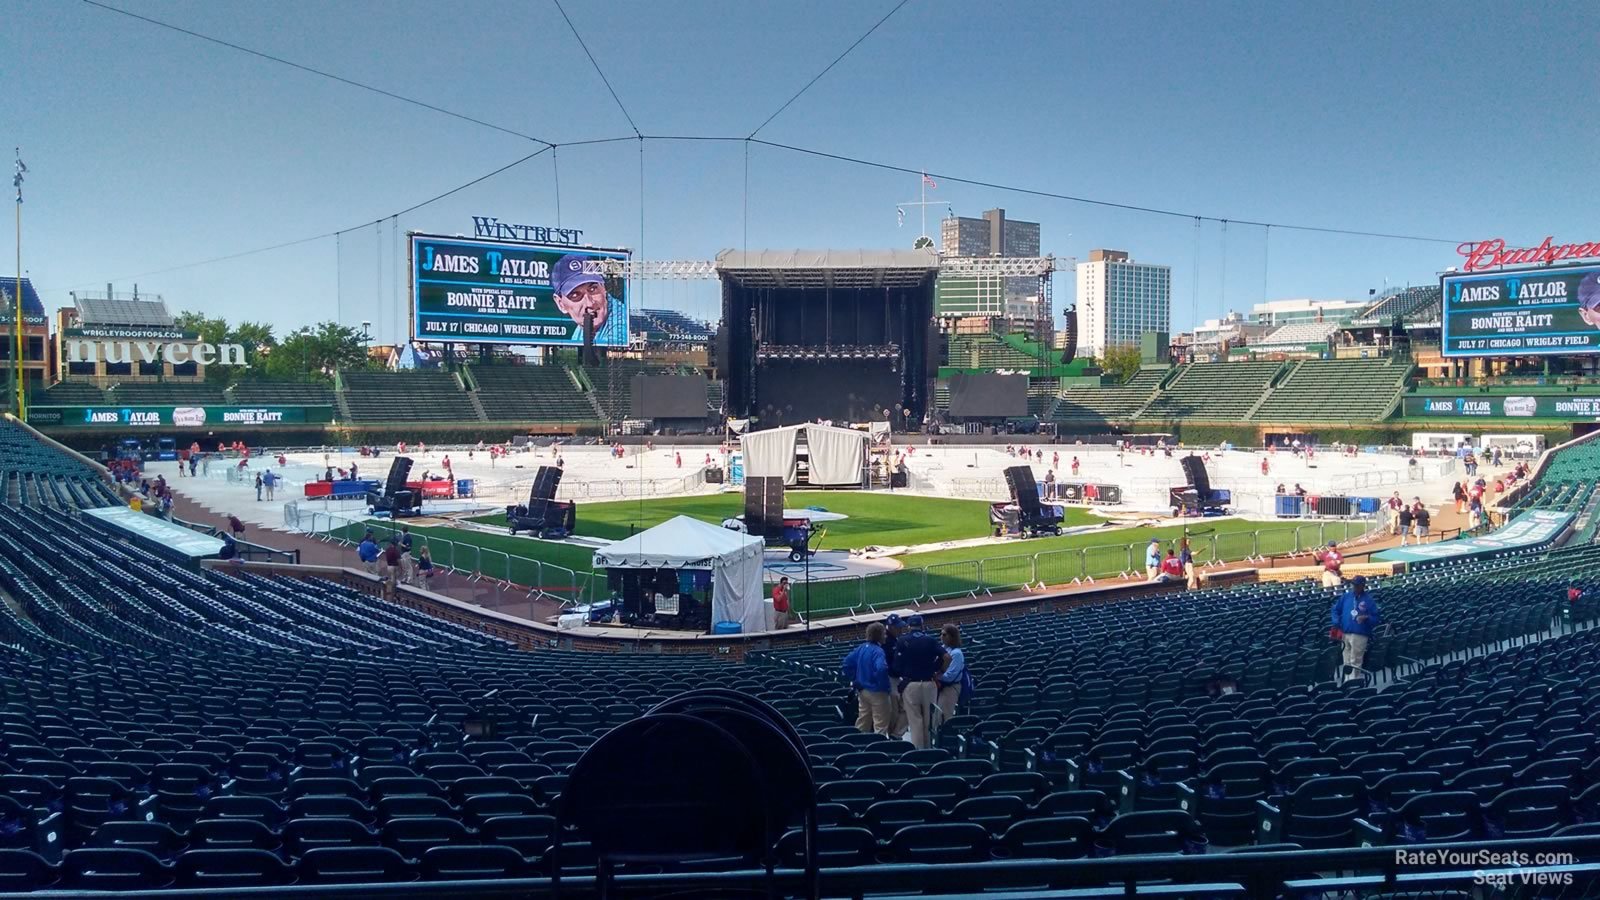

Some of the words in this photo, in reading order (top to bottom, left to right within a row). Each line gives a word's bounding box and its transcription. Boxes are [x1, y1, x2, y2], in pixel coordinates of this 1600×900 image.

[472, 216, 583, 245] WINTRUST
[447, 292, 494, 308] BONNIE
[498, 295, 537, 310] RAITT
[426, 321, 447, 332] JULY
[450, 322, 458, 332] 17
[464, 322, 498, 333] CHICAGO
[503, 324, 541, 335] WRIGLEY
[543, 325, 567, 336] FIELD
[1471, 316, 1513, 329] BONNIE
[1516, 314, 1553, 327] RAITT
[82, 329, 183, 339] WRIGLEYROOFTOPS.COM
[1458, 340, 1476, 349] JULY
[1478, 340, 1485, 348] 17
[1490, 338, 1521, 348] CHICAGO
[1526, 336, 1563, 346] WRIGLEY
[1565, 335, 1590, 345] FIELD
[66, 340, 248, 365] nuveen
[1556, 402, 1590, 412] BONNIE
[224, 412, 255, 421] BONNIE
[257, 412, 282, 421] RAITT
